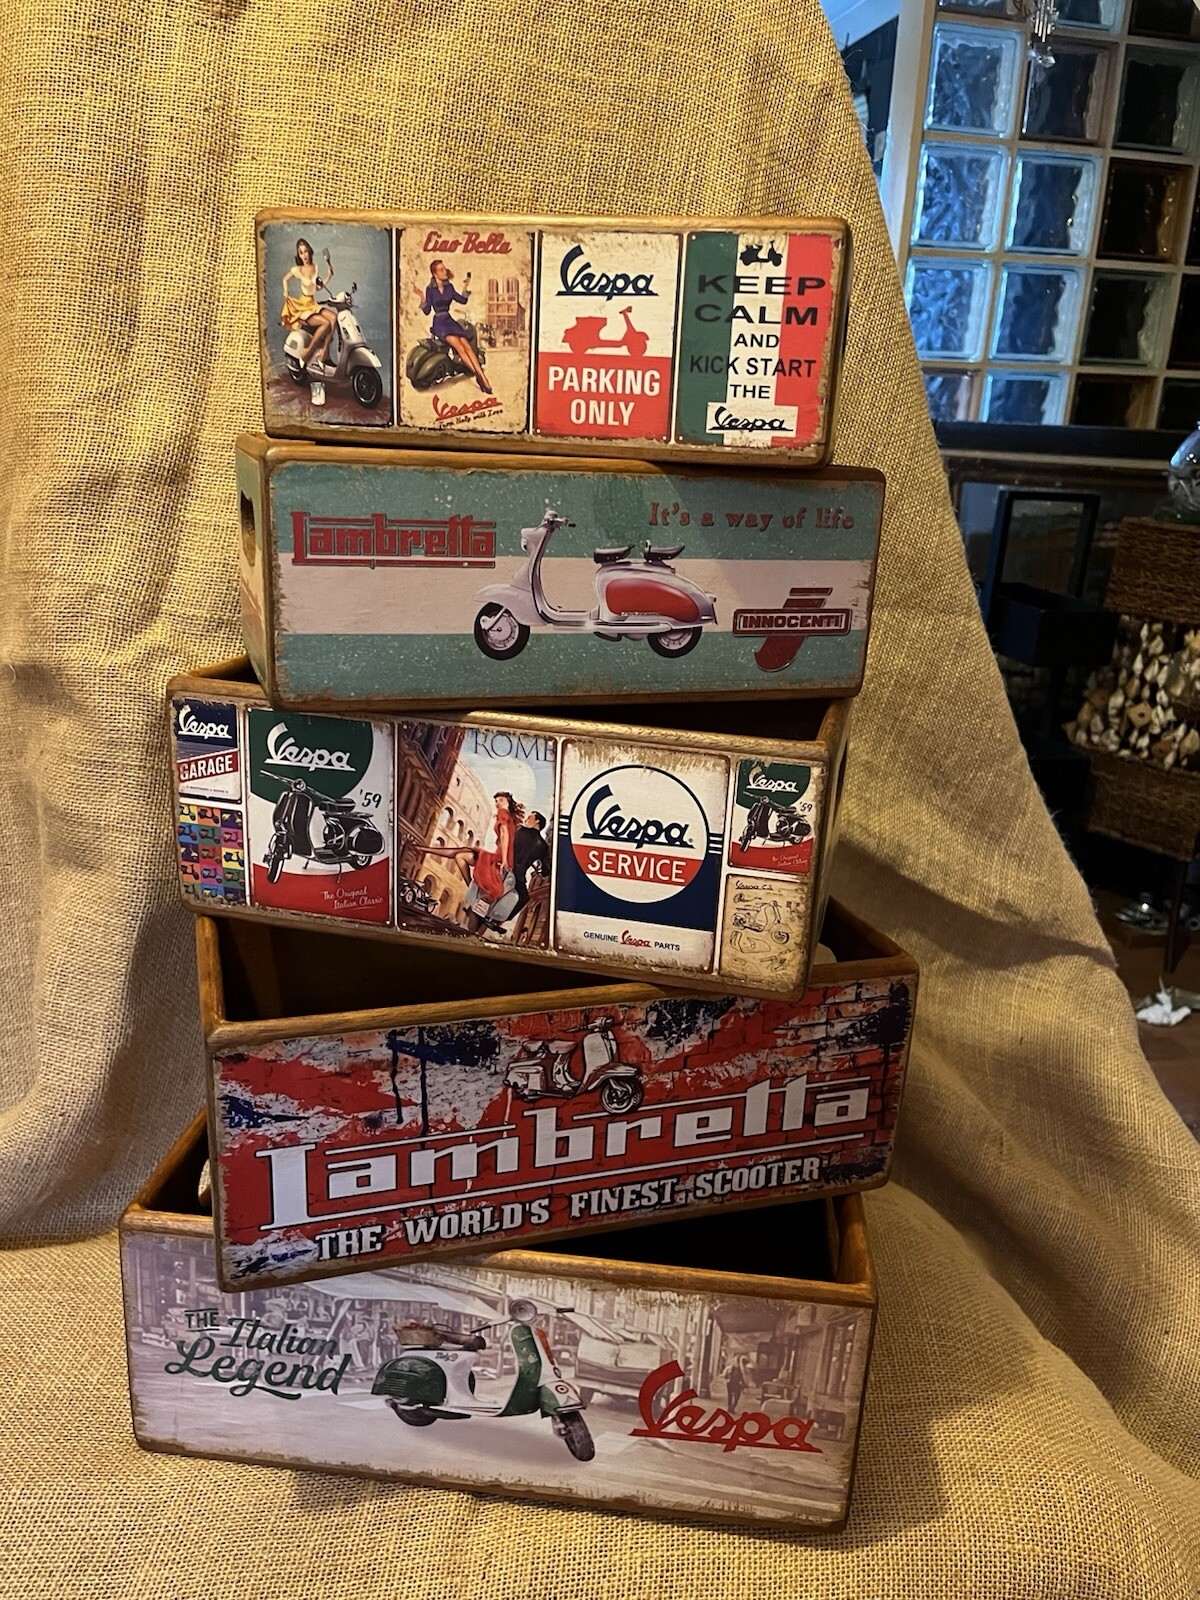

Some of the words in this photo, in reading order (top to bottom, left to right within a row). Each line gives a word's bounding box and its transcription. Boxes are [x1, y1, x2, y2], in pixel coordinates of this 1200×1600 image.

[423, 231, 461, 253] Ciao
[462, 232, 512, 254] Bella
[555, 245, 659, 301] Vespa
[697, 274, 826, 296] KEEP
[694, 304, 818, 326] CALM
[734, 334, 779, 348] AND
[548, 366, 660, 397] PARKING
[690, 355, 739, 376] KICK
[746, 358, 816, 378] START
[729, 384, 771, 399] THE
[433, 394, 503, 421] Vespa
[570, 398, 635, 426] ONLY
[708, 406, 794, 432] Vespa
[649, 502, 691, 527] It's
[701, 512, 715, 527] a
[725, 511, 773, 532] way
[782, 508, 806, 529] of
[815, 507, 855, 529] life
[290, 511, 496, 569] Lambretta
[742, 614, 843, 629] INNOCENTI
[178, 704, 233, 740] Vespa
[264, 722, 357, 772] Vespa
[474, 730, 555, 762] ROME
[179, 755, 234, 781] GARAGE
[746, 762, 799, 793] Vespa
[580, 784, 695, 849] Vespa
[587, 850, 687, 883] SERVICE
[322, 890, 335, 900] The
[336, 886, 367, 899] Original
[333, 900, 357, 909] Italian
[359, 896, 384, 906] Classic
[583, 931, 618, 943] GENUINE
[620, 929, 652, 947] Vespa
[654, 941, 680, 951] PARTS
[255, 1073, 871, 1231] Lambretta
[315, 1224, 383, 1261] THE
[405, 1198, 550, 1245] WORLD'S
[569, 1178, 678, 1218] FINEST
[695, 1157, 822, 1199] SCOOTER
[185, 1308, 219, 1331] THE
[220, 1317, 338, 1359] Italian
[164, 1335, 352, 1400] Legend
[627, 1359, 823, 1453] Vespa
